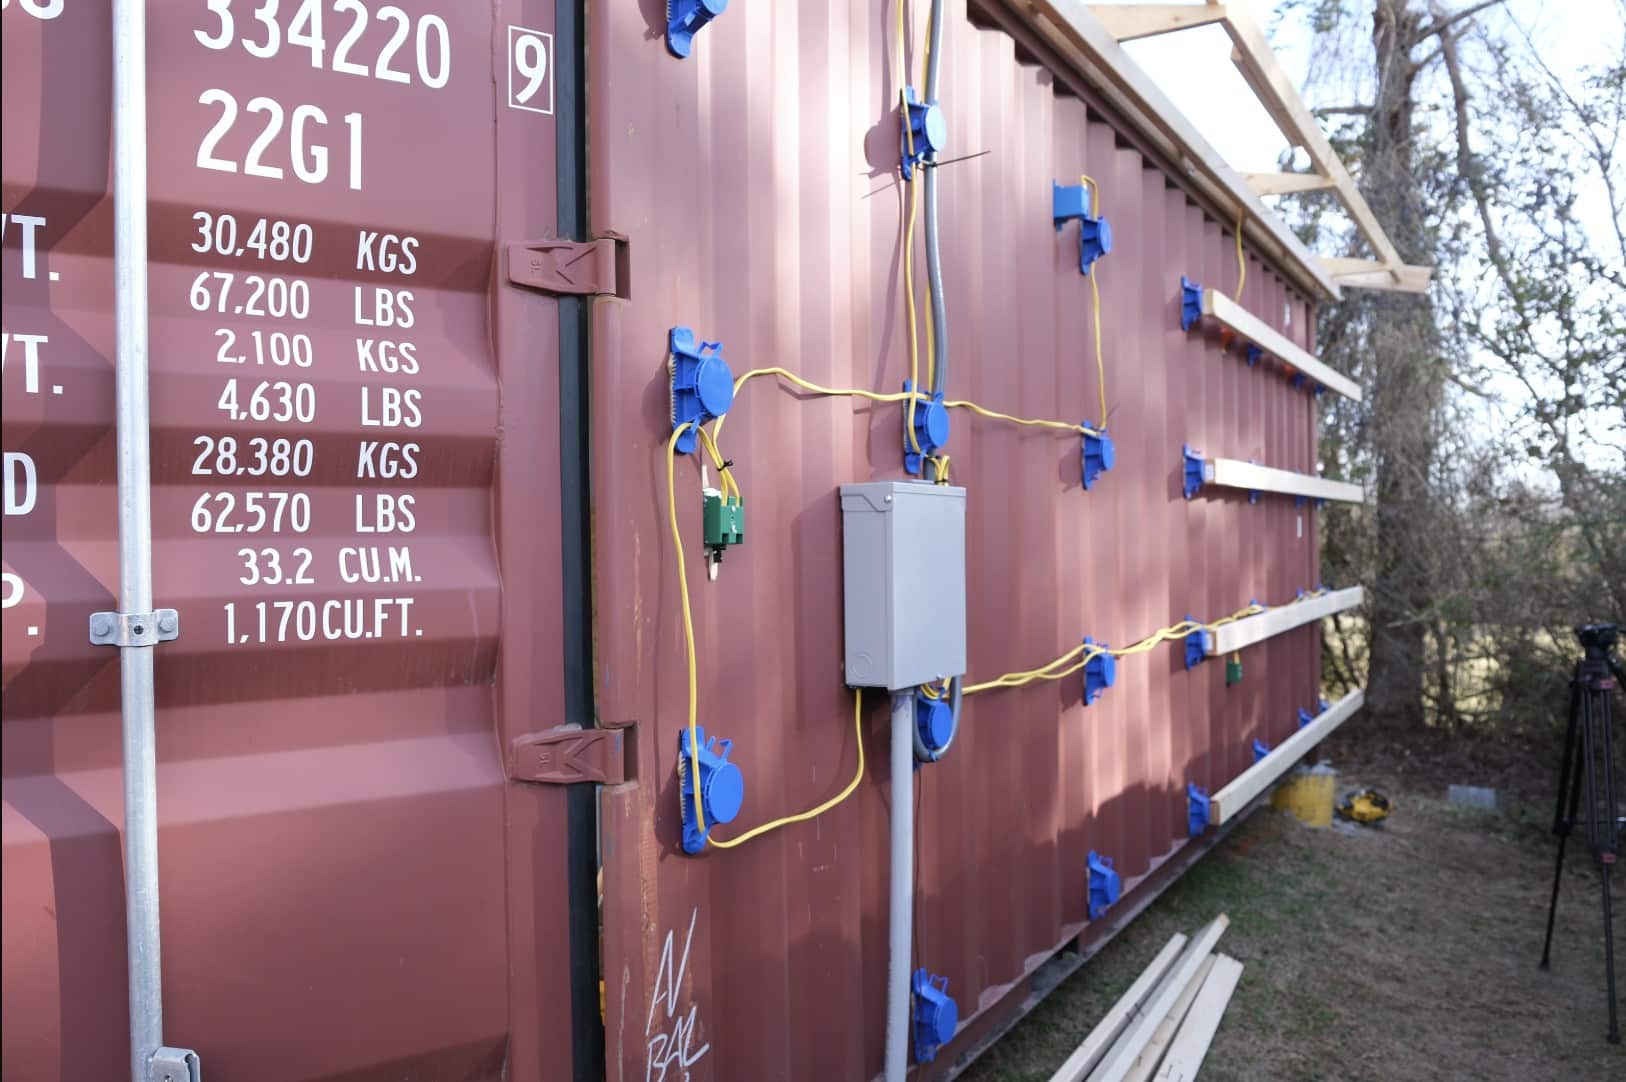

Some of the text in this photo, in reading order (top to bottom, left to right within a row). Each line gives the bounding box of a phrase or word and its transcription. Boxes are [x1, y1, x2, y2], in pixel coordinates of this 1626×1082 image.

[193, 0, 547, 105] 334220 9
[196, 88, 363, 191] 22G1
[2, 213, 60, 281] T.
[191, 211, 419, 275] 30,480 KGS
[354, 286, 415, 329] LBS
[2, 332, 64, 395] T.
[355, 338, 420, 375] KGS
[217, 378, 422, 428] 4,630 LBS
[191, 435, 420, 479] 28,380 KGS
[191, 491, 416, 533] 62,570 LBS
[237, 546, 422, 586] 33.2 CU.M.
